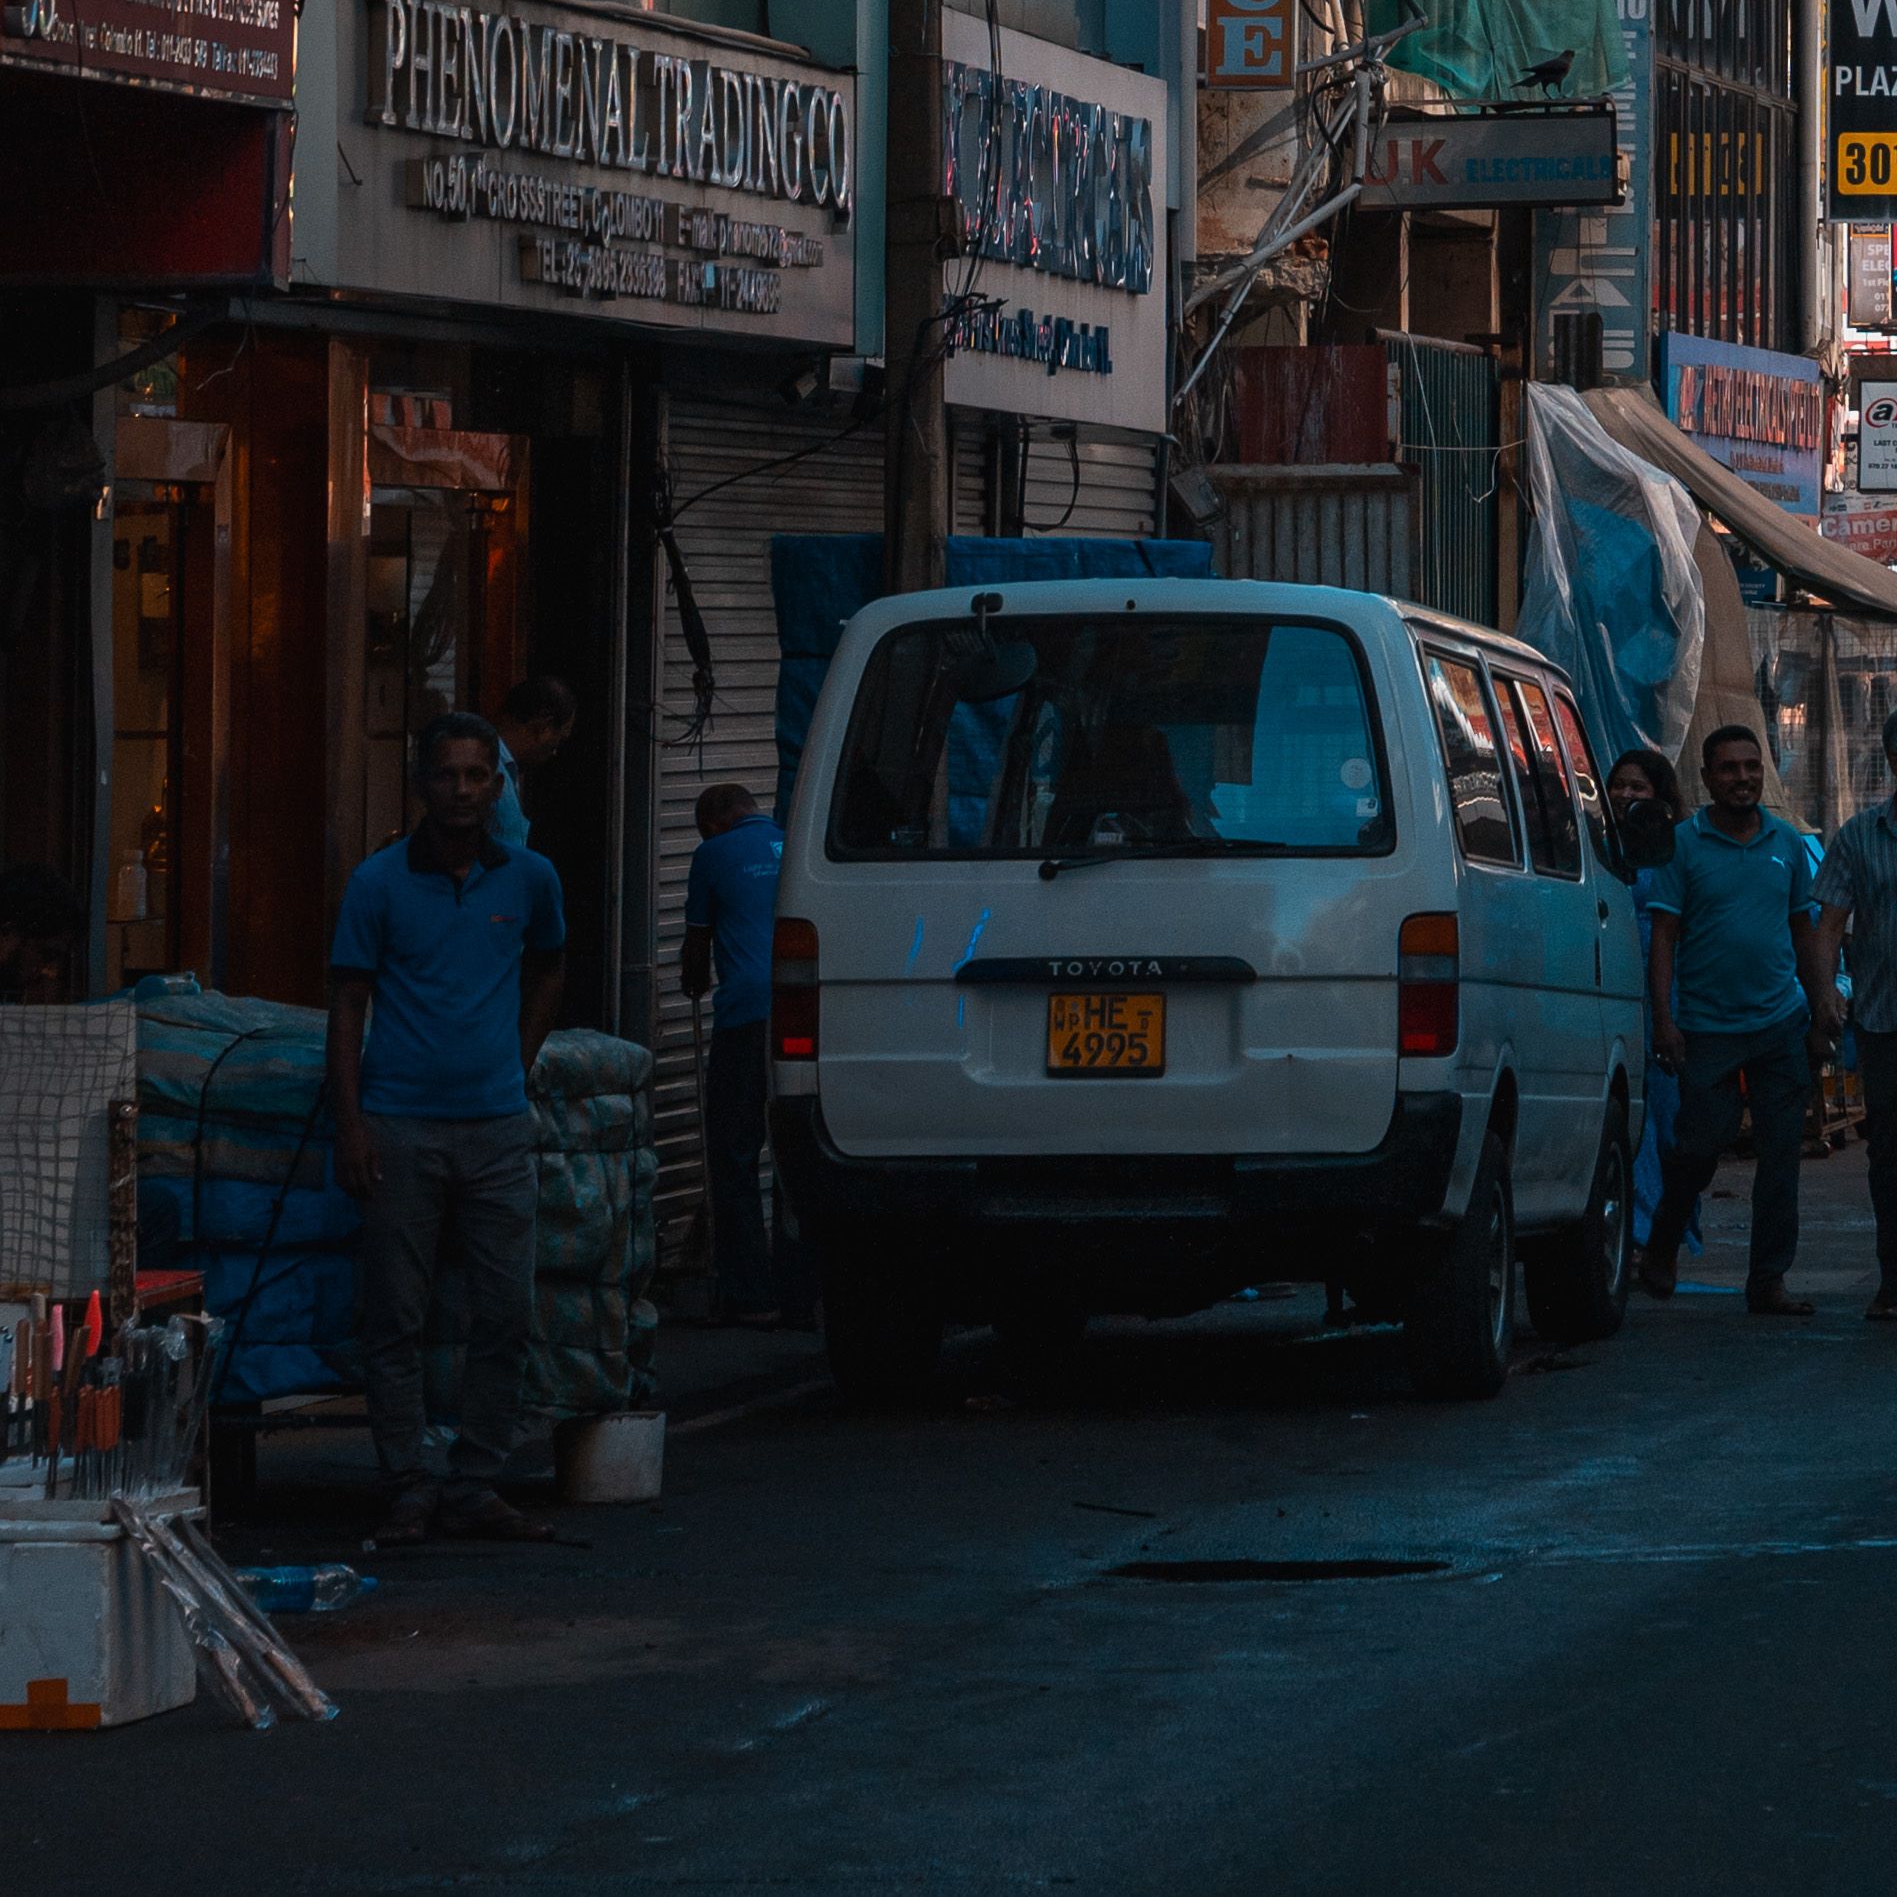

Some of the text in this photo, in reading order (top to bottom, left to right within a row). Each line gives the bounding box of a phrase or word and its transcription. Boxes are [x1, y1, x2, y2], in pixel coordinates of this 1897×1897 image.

[652, 53, 804, 202] TRADING
[1049, 960, 1163, 977] TOYOTA
[1062, 1032, 1149, 1067] 4995
